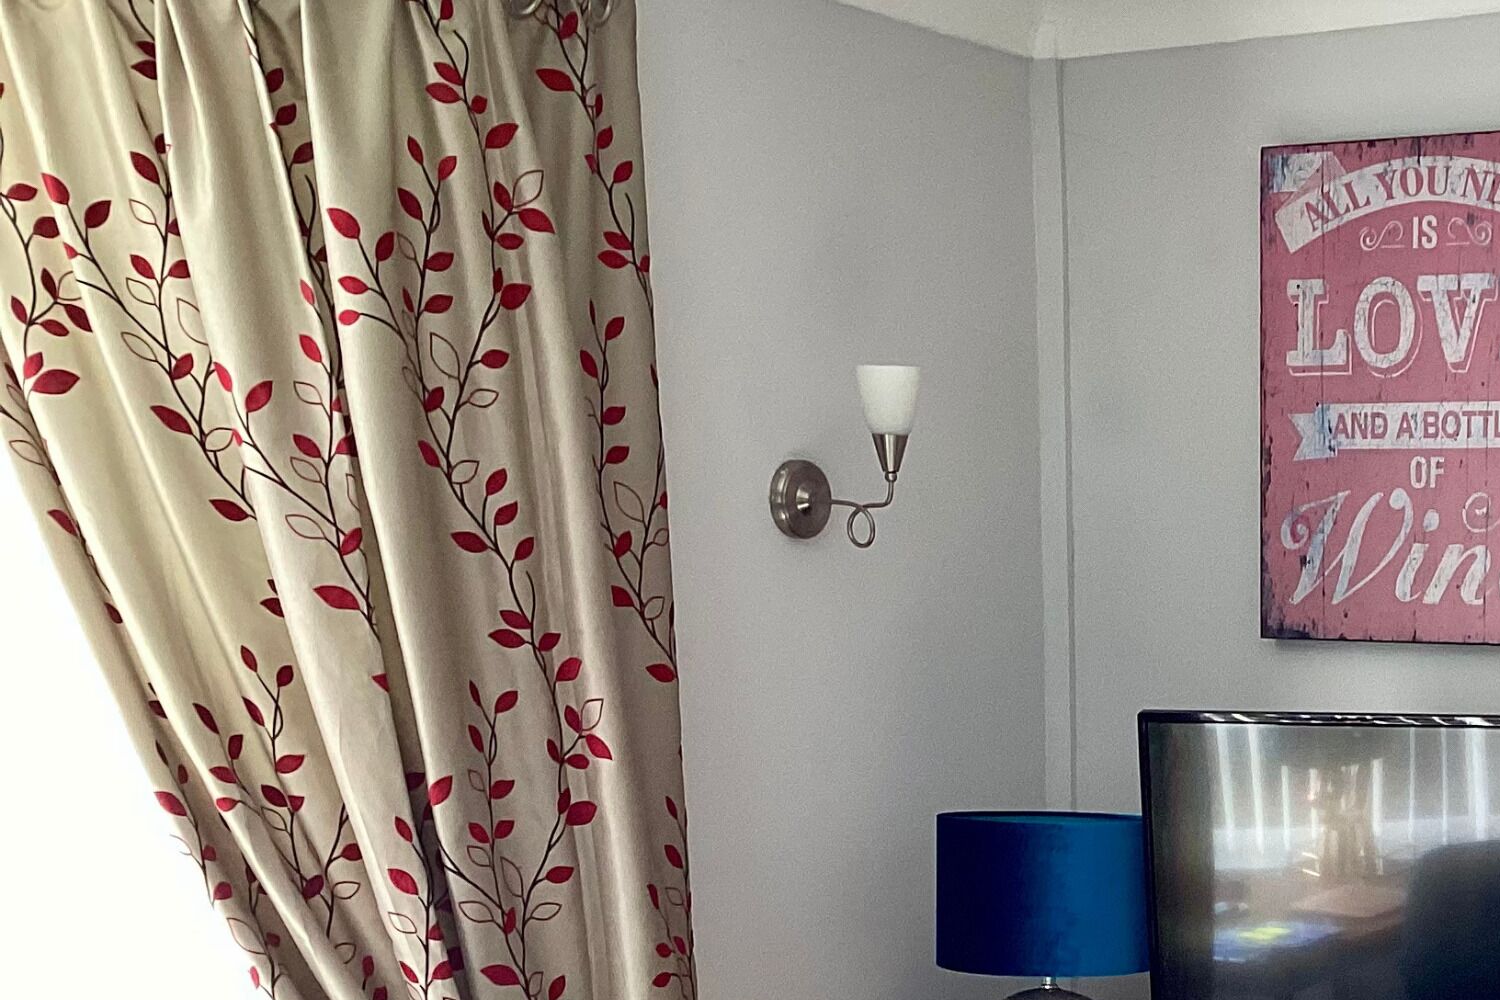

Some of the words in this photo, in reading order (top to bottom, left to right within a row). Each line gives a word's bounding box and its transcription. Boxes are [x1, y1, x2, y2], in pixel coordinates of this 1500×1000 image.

[1303, 179, 1372, 232] ALL
[1376, 166, 1450, 201] YOU
[1412, 215, 1438, 249] IS
[1334, 411, 1389, 440] AND
[1396, 411, 1414, 439] A
[1410, 456, 1445, 489] OF
